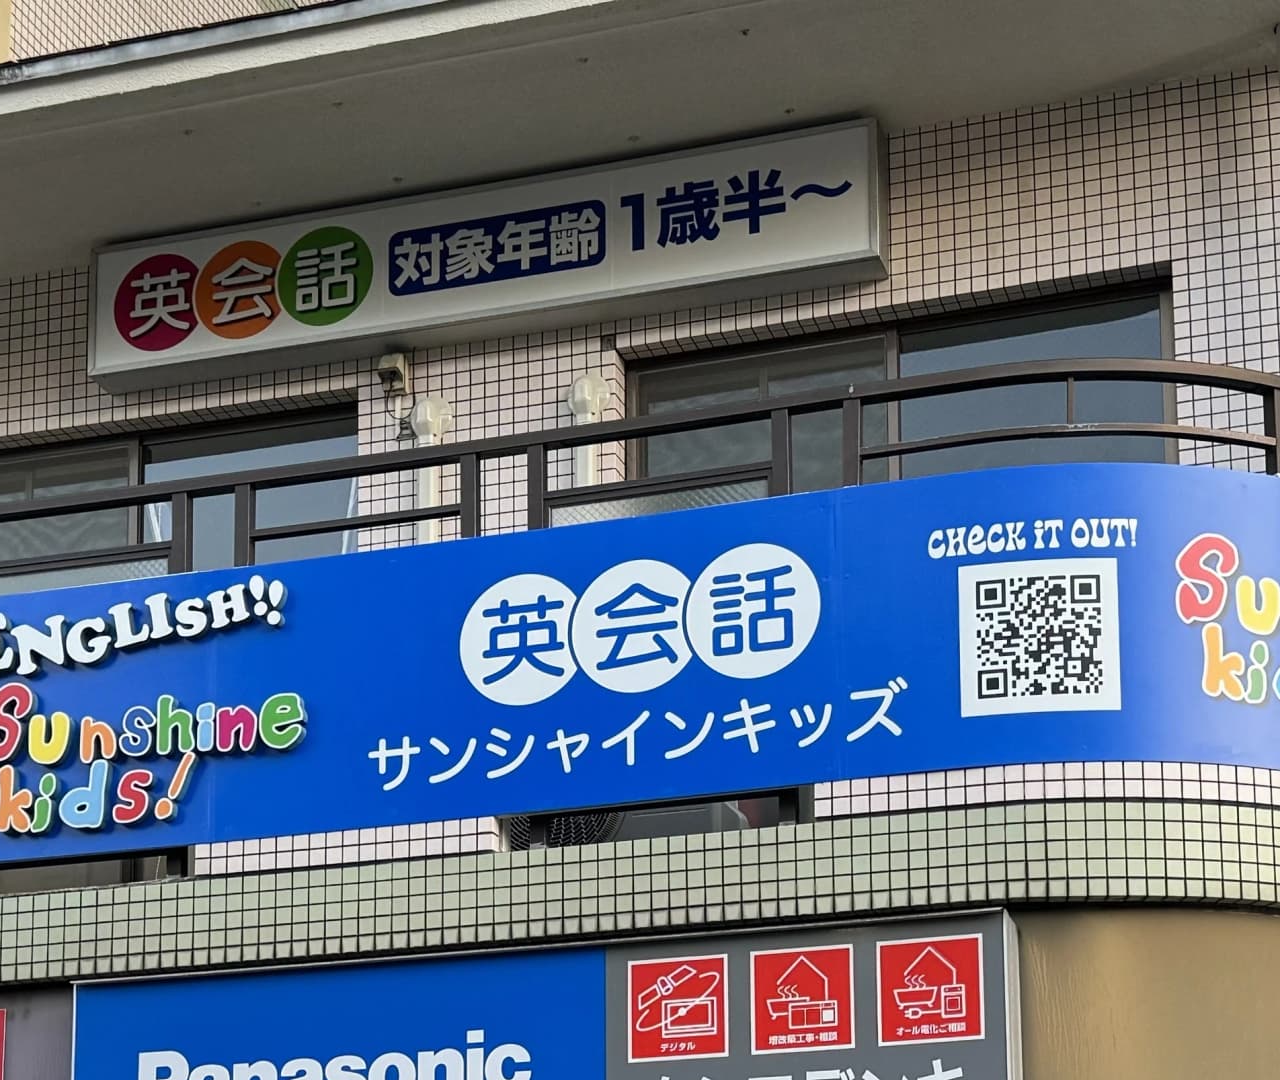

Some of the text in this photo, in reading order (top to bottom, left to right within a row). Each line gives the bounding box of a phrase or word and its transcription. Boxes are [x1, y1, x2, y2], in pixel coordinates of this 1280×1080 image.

[392, 208, 602, 289] 対象年齢
[128, 246, 358, 340] 英会話
[1070, 517, 1139, 549] OUT!
[481, 563, 796, 685] 英会話
[368, 675, 909, 791] サンシャインキッズ
[659, 1040, 697, 1053] デジタル
[895, 1022, 968, 1037] オール電化ご相談
